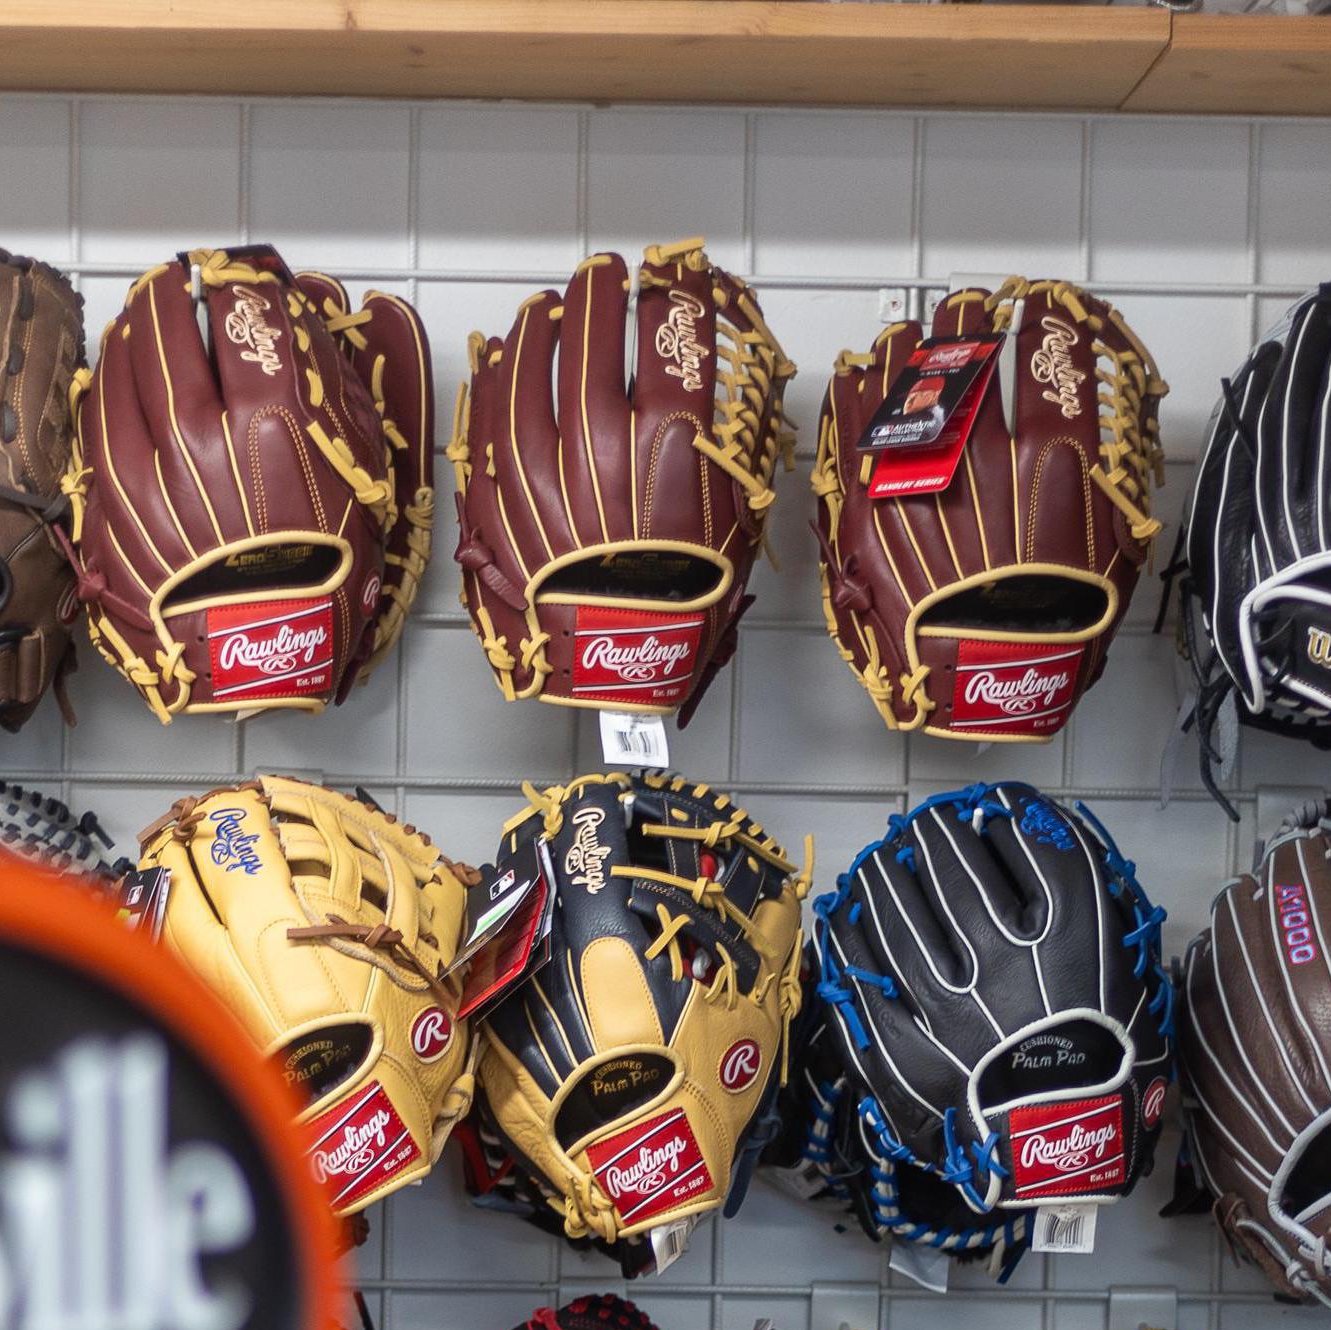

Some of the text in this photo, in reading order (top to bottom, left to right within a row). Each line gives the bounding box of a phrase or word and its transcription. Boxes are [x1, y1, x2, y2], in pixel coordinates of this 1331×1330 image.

[666, 290, 709, 392] Rawlings
[220, 625, 327, 671] Rawlings
[582, 636, 690, 674] Rawlings
[964, 668, 1069, 705] Rawlings
[210, 807, 264, 876] Rawlings
[573, 807, 608, 896] Rawlings
[1275, 883, 1316, 965] A1000
[413, 1010, 449, 1053] R
[590, 1068, 661, 1096] PALM PAD
[723, 1044, 758, 1086] R
[1011, 1050, 1087, 1070] PALM PAD
[312, 1108, 391, 1184] Rawlings
[607, 1136, 687, 1199] Rawlings
[1021, 1124, 1116, 1169] Rawlings
